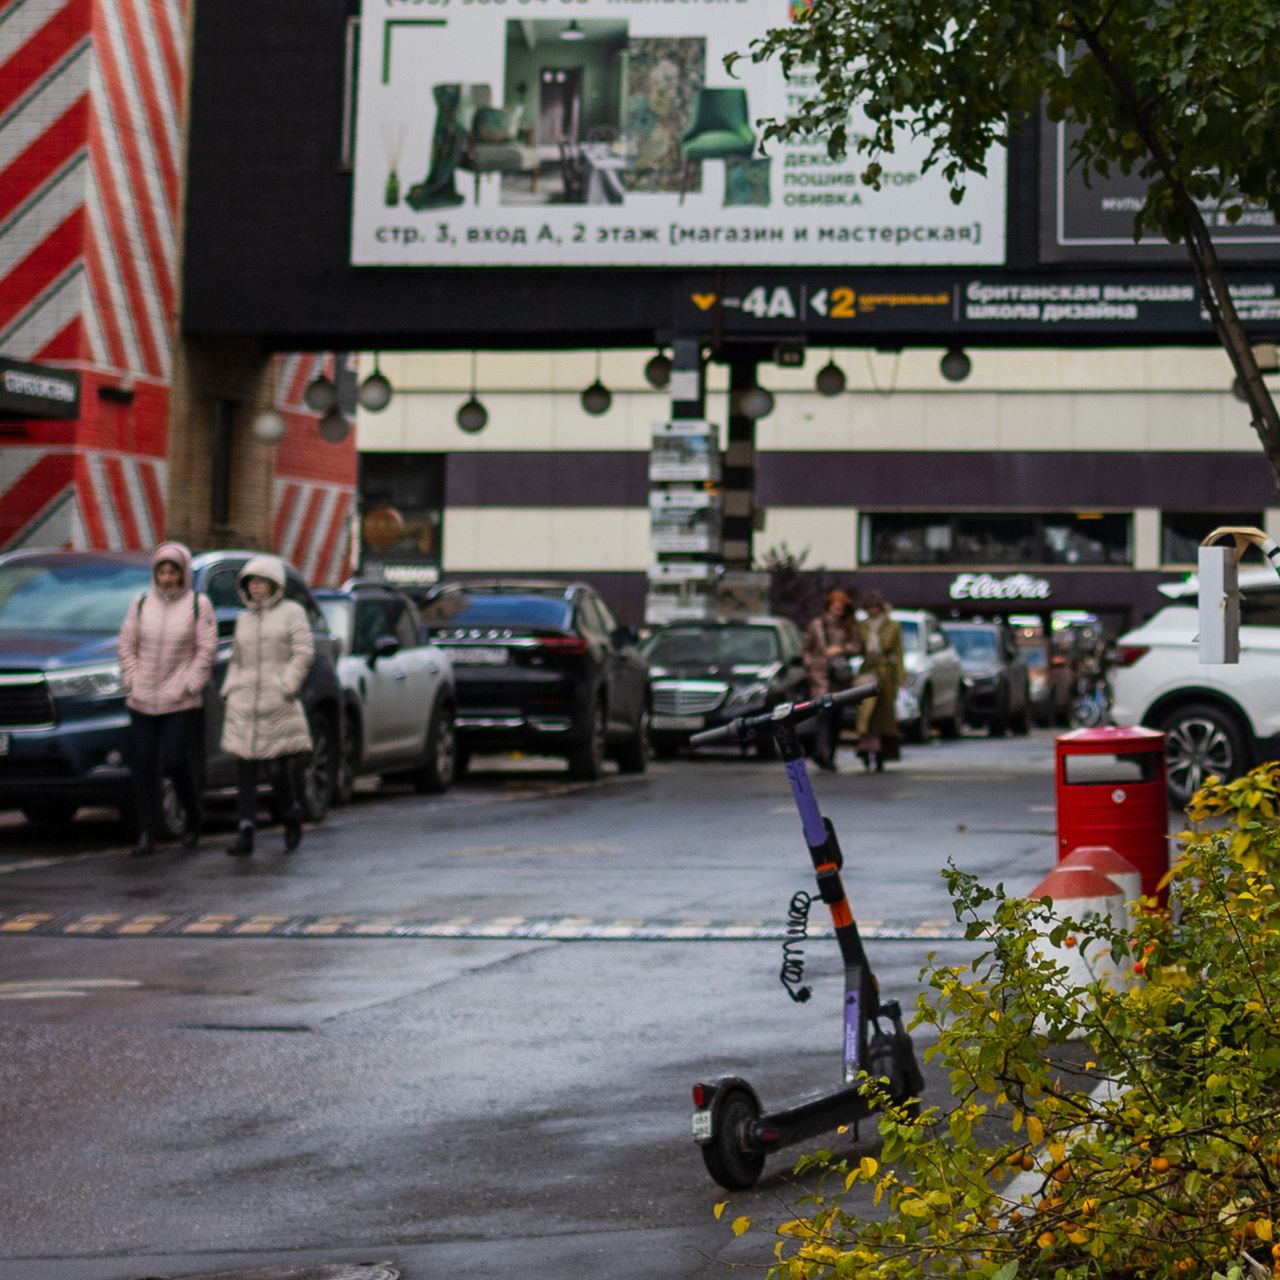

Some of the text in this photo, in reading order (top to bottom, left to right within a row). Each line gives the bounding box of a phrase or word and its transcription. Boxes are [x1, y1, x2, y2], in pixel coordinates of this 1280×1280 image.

[784, 173, 918, 186] ПОШИВ ТОР
[784, 193, 862, 206] ОБИВКА
[375, 222, 982, 245] стр. 3, вход А, 2 этаж [магазин и мастерская]
[830, 286, 856, 318] 2
[967, 281, 1194, 303] британская высшая
[967, 301, 1137, 322] школа дизайна
[949, 573, 1051, 599] Electra
